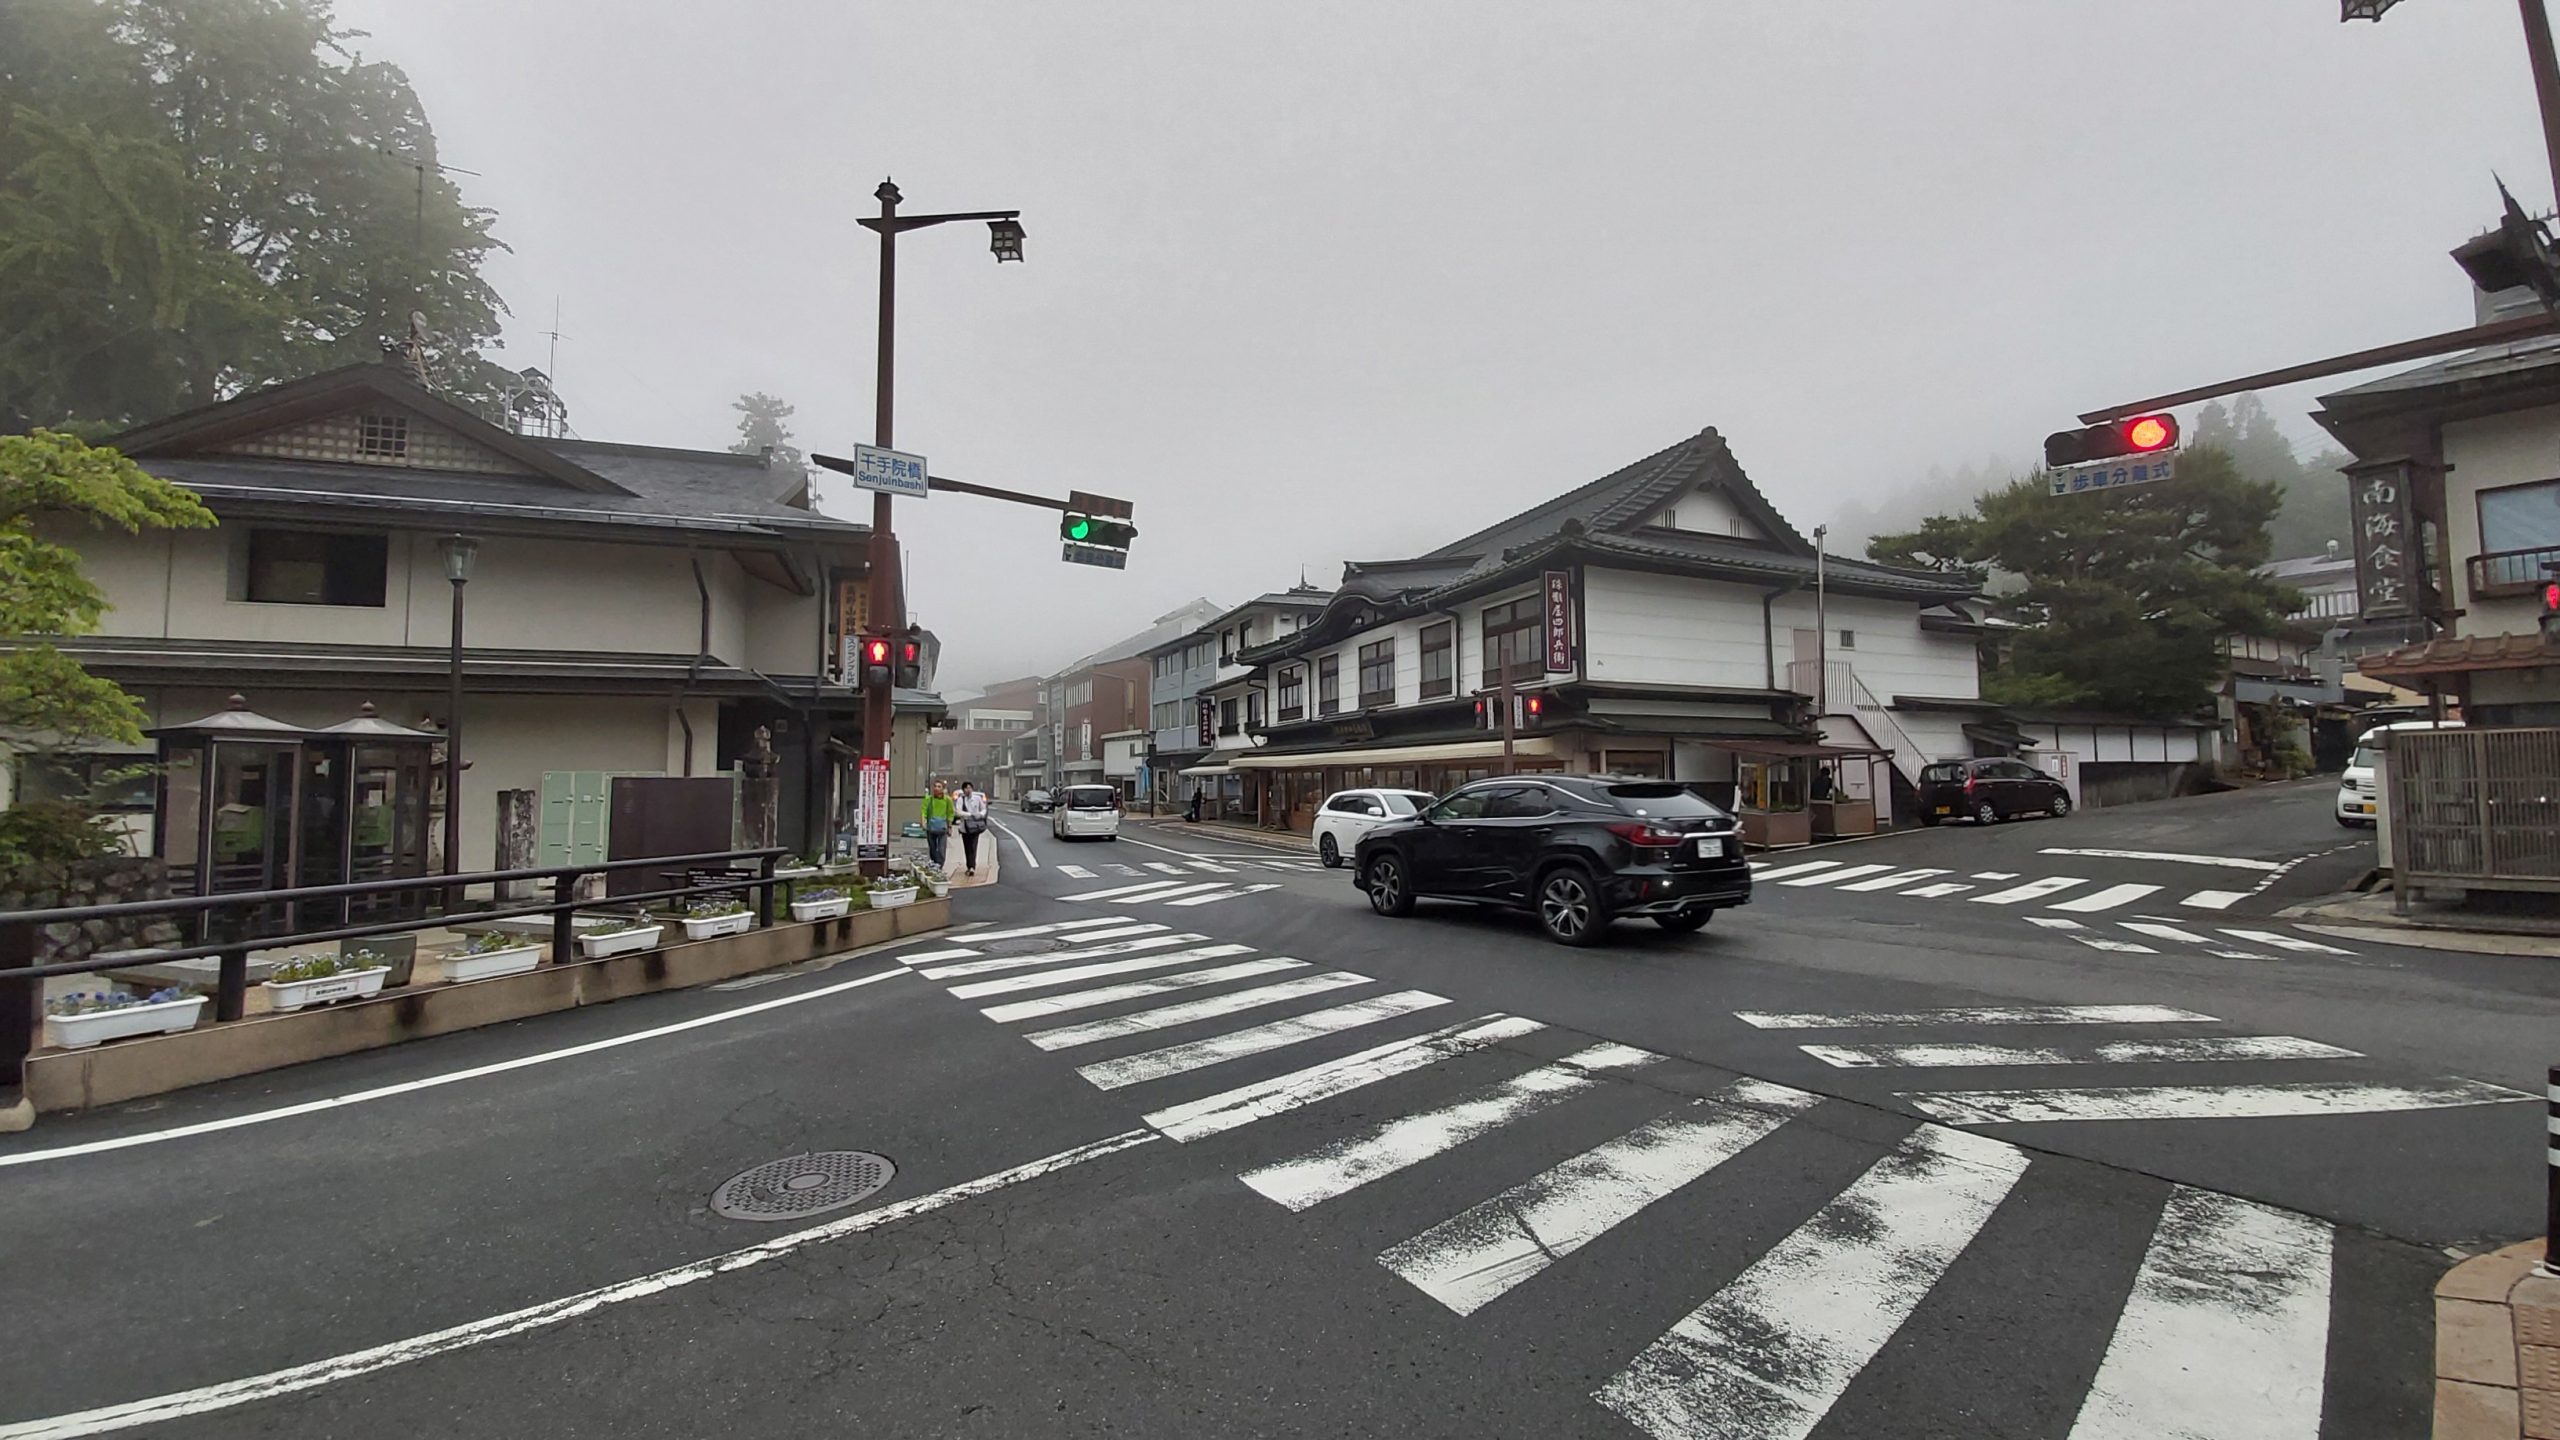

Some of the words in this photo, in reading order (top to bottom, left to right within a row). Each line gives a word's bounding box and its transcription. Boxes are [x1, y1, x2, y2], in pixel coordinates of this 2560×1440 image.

[860, 453, 922, 480] 千手院橋
[2073, 461, 2170, 491] 歩車分離式
[858, 471, 924, 491] Senjuinbashi
[2363, 479, 2405, 602] 南海食堂
